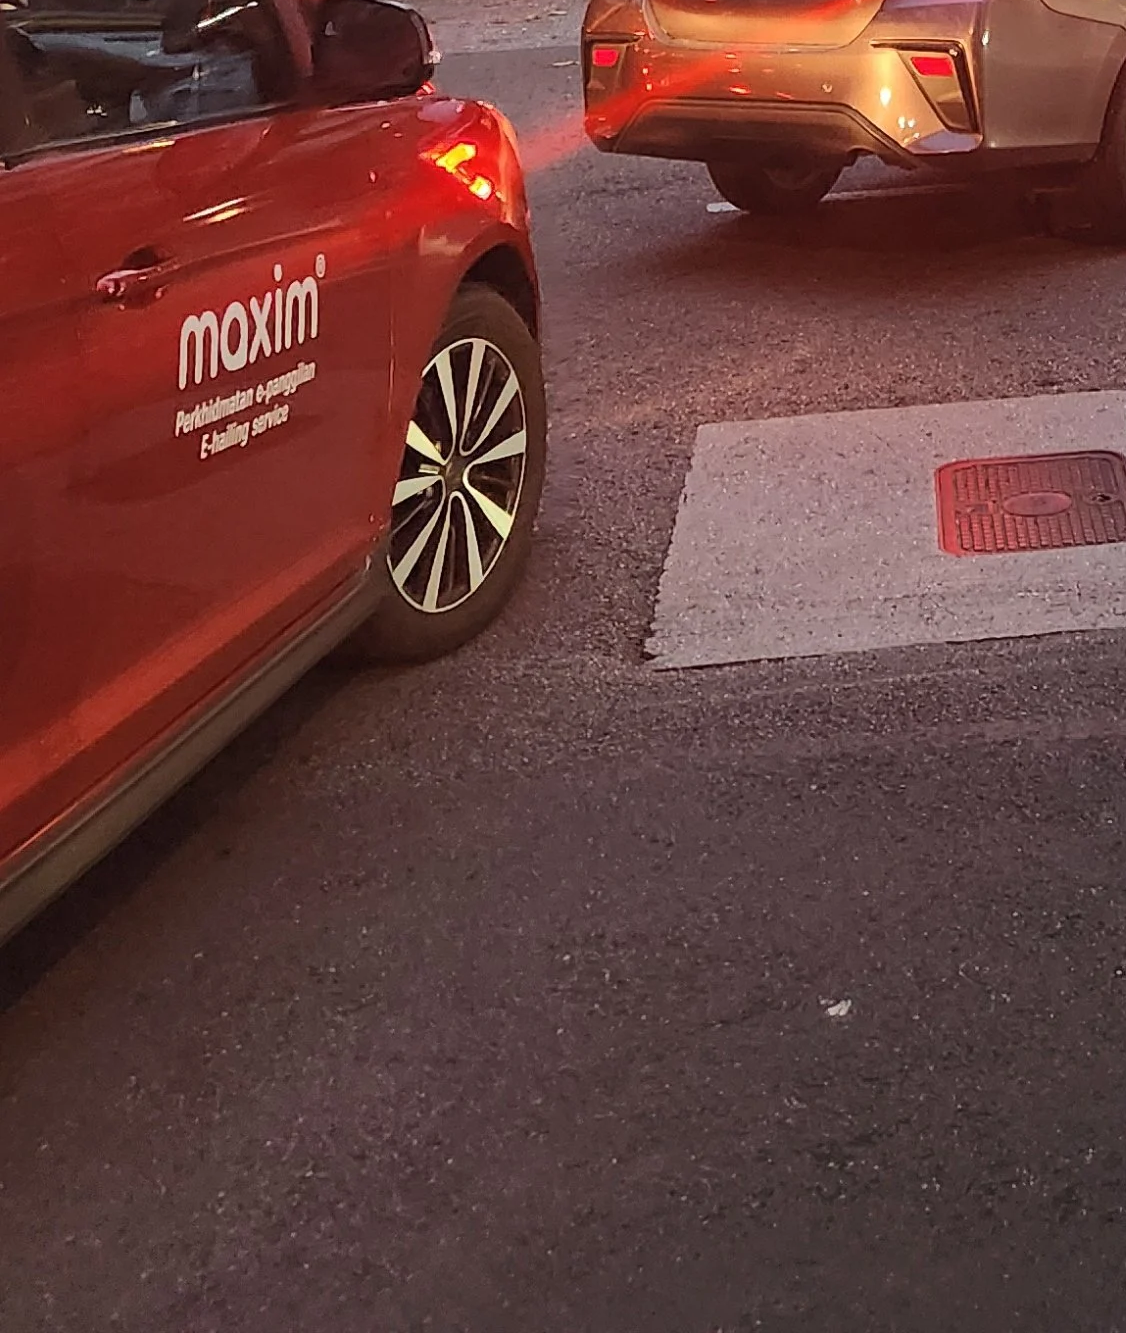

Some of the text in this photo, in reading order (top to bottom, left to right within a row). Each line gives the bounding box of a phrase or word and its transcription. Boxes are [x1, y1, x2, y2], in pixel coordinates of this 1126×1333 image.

[179, 263, 318, 390] maxim
[175, 361, 317, 437] Perkhidmatan e-panggilan
[200, 403, 290, 460] E-hailing service
